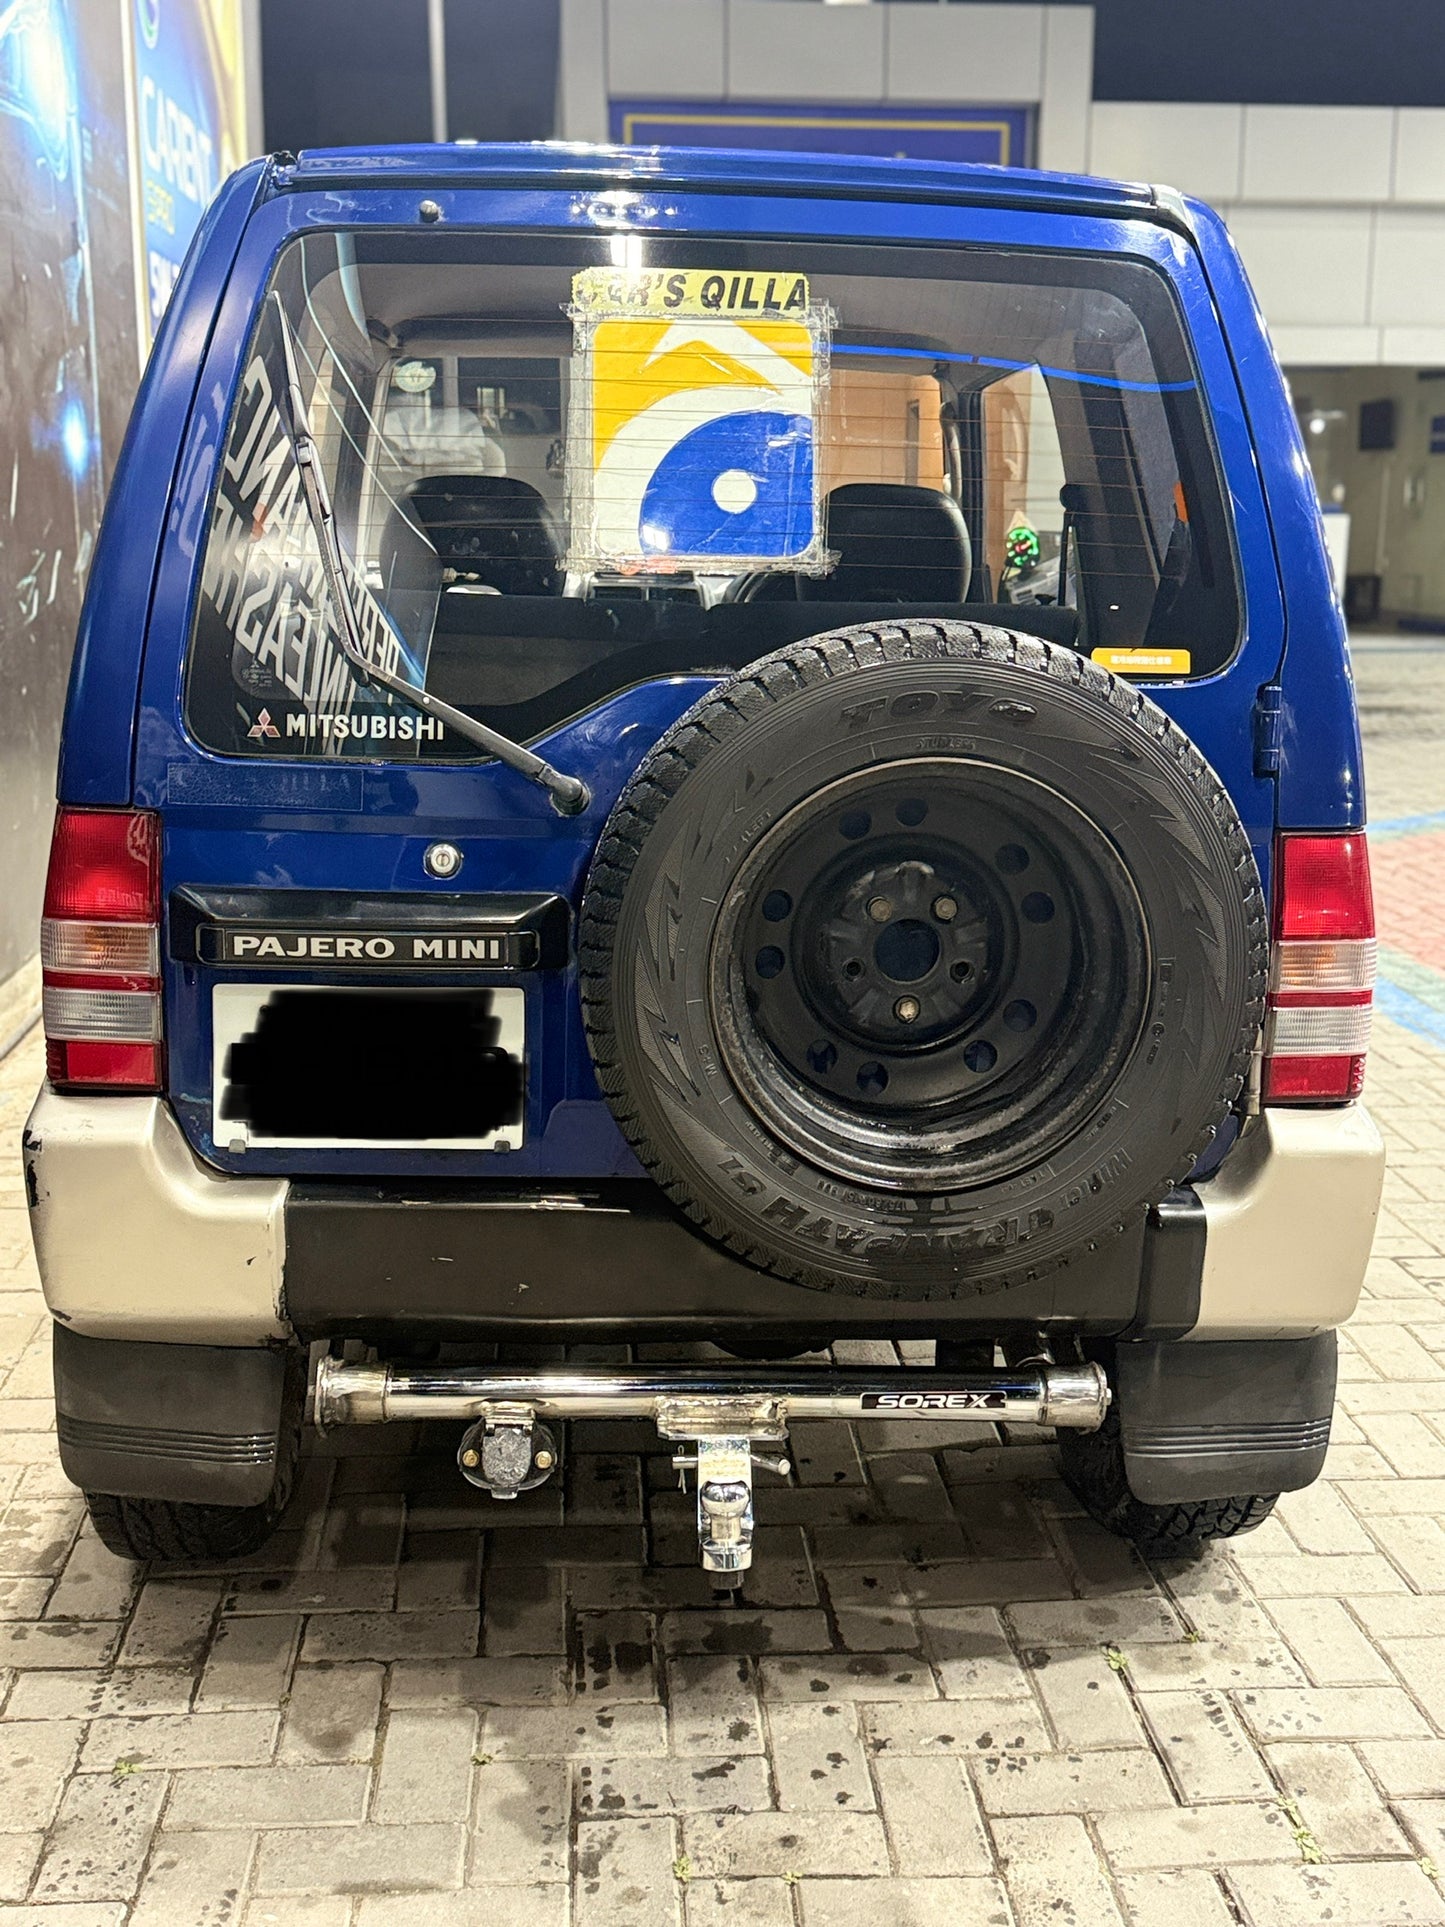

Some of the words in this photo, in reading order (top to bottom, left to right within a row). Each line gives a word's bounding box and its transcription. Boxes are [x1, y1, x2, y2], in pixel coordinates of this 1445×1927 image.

[700, 274, 807, 311] QILLA
[838, 690, 1039, 724] TOYO
[286, 713, 445, 741] MITSUBISHI
[233, 936, 396, 959] PAJERO
[413, 939, 500, 960] MINI
[875, 1393, 992, 1410] SOREX
